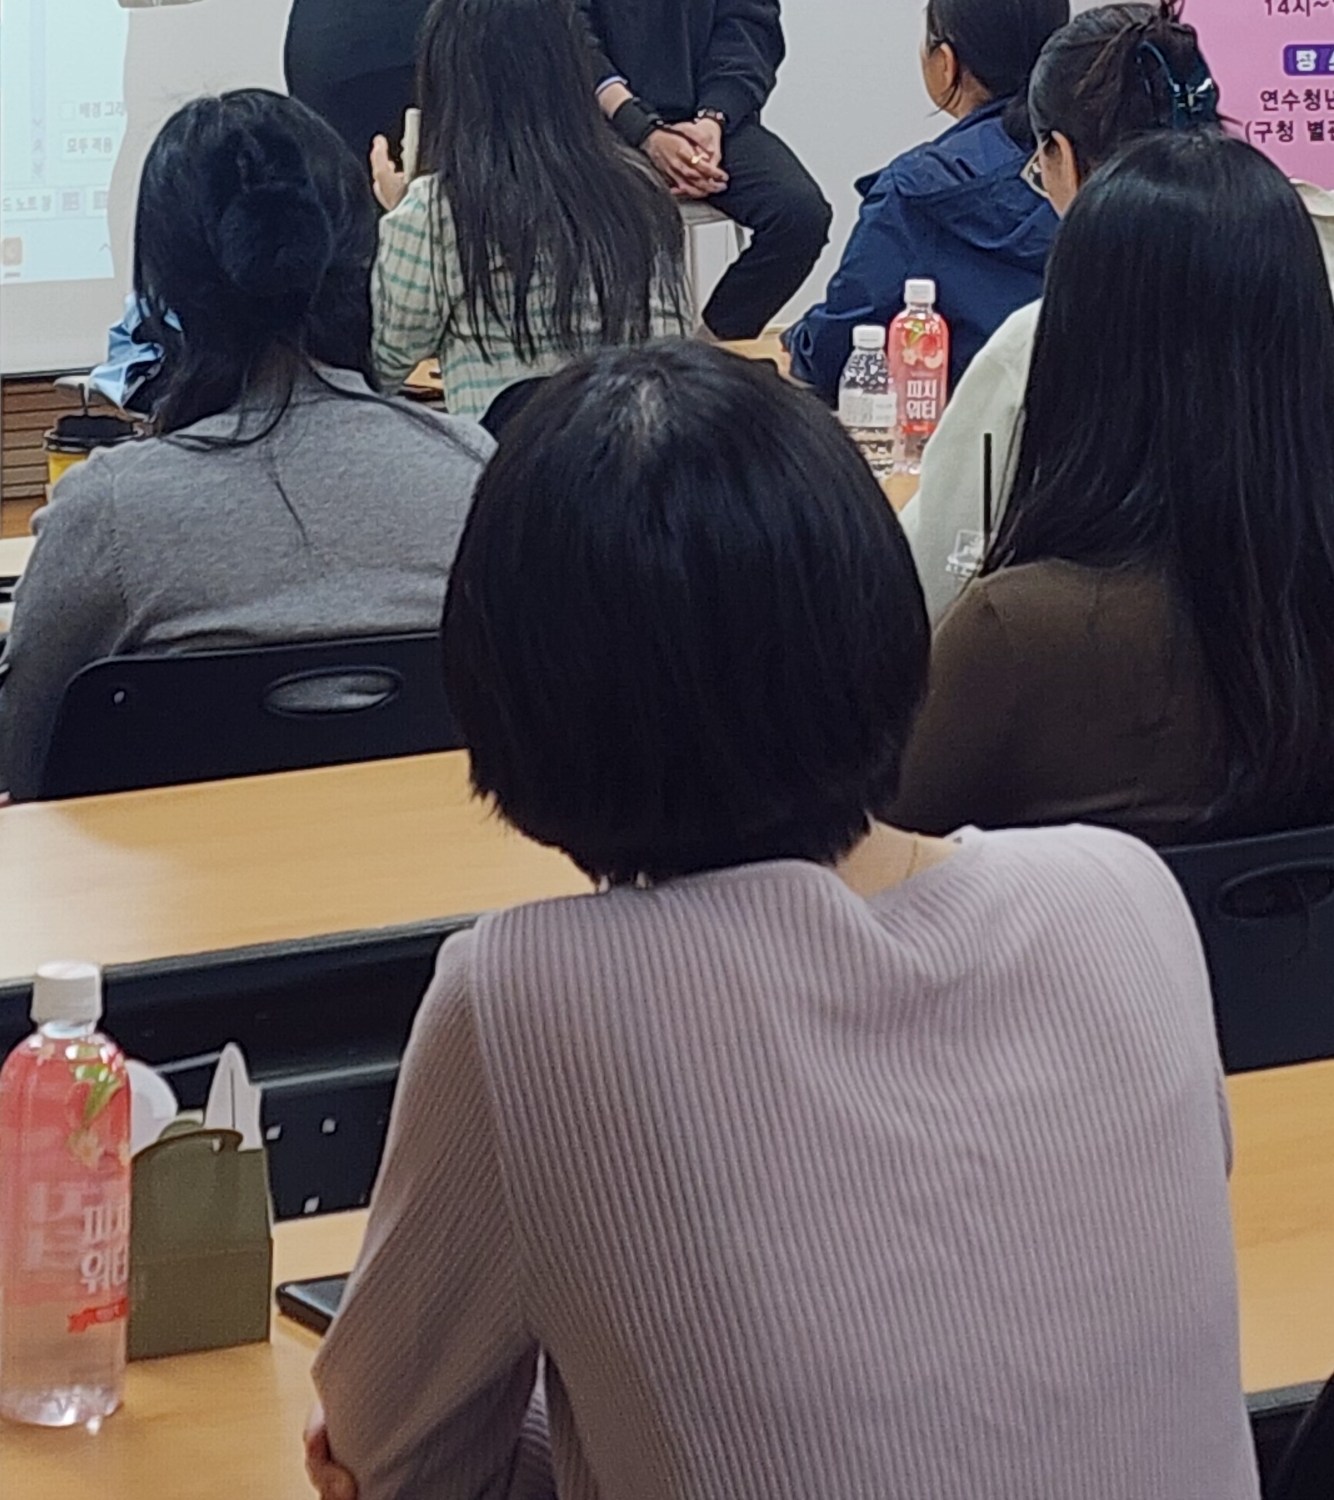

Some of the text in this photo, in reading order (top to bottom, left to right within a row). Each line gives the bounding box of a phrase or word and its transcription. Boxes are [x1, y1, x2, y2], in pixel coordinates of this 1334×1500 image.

[1296, 50, 1317, 72] 장
[1244, 120, 1294, 144] (구청
[906, 400, 937, 419] 워터
